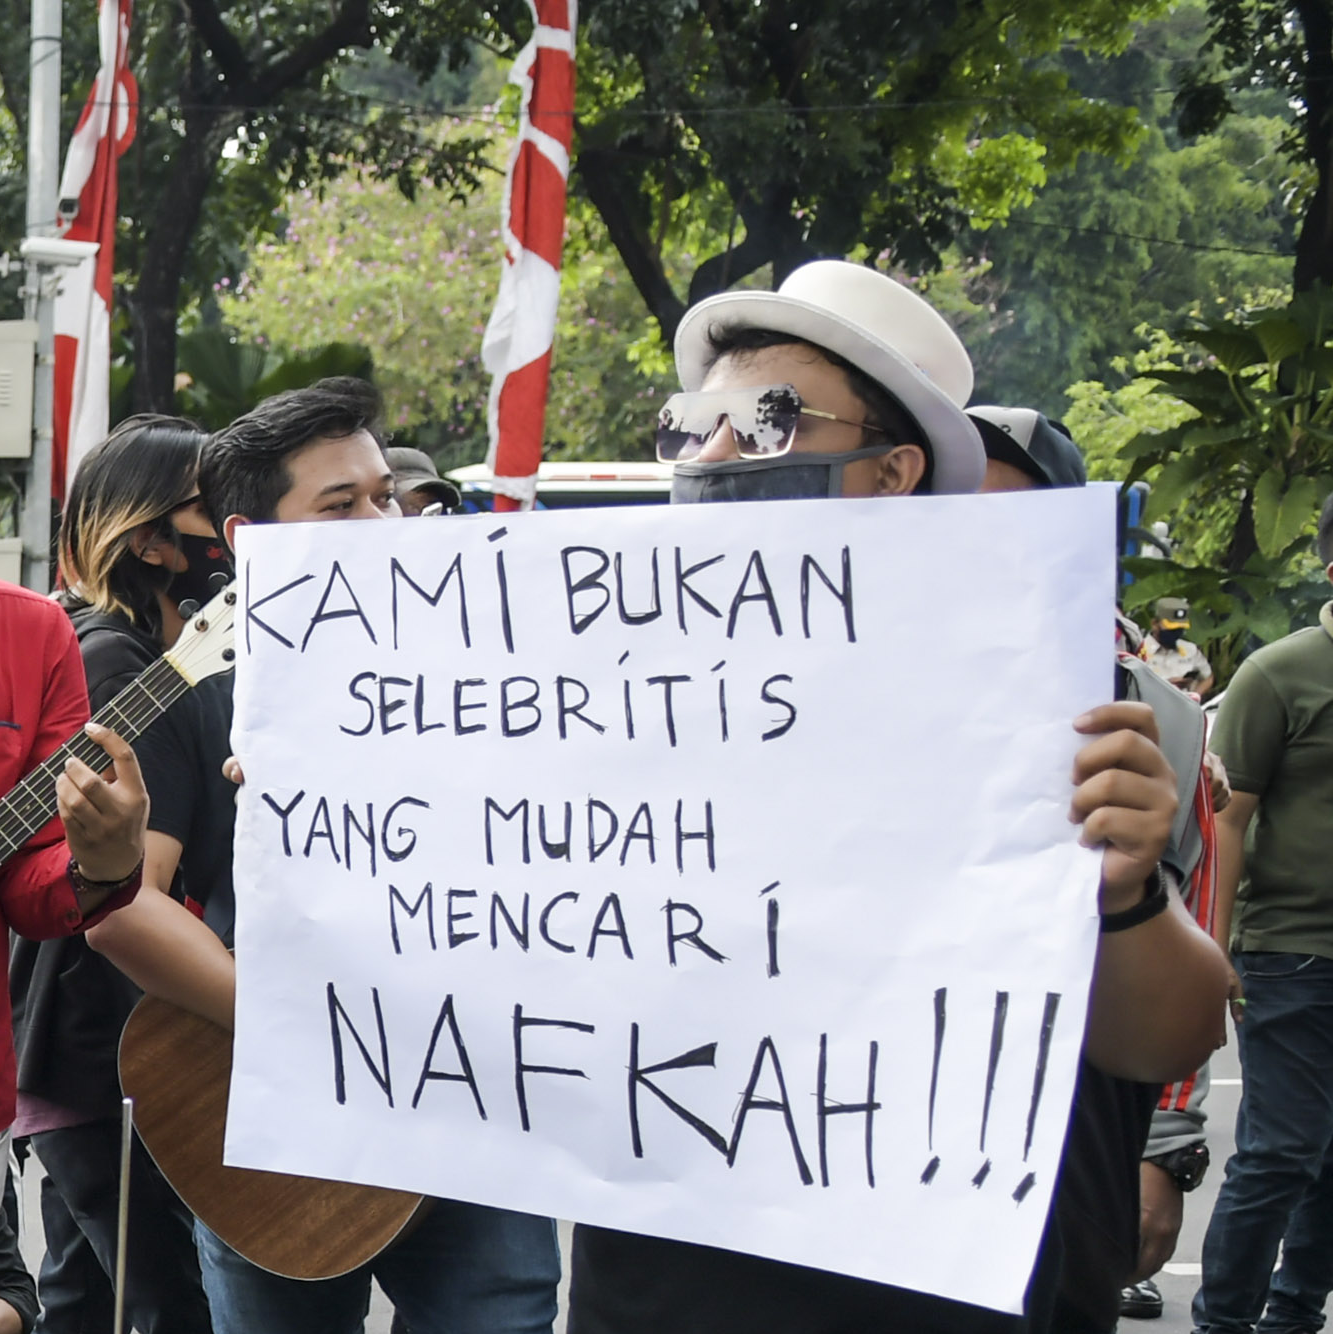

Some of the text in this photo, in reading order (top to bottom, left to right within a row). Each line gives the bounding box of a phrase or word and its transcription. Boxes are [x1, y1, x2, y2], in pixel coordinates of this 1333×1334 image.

[562, 544, 857, 643] BUKAN
[261, 789, 717, 877] YANG MUDAH
